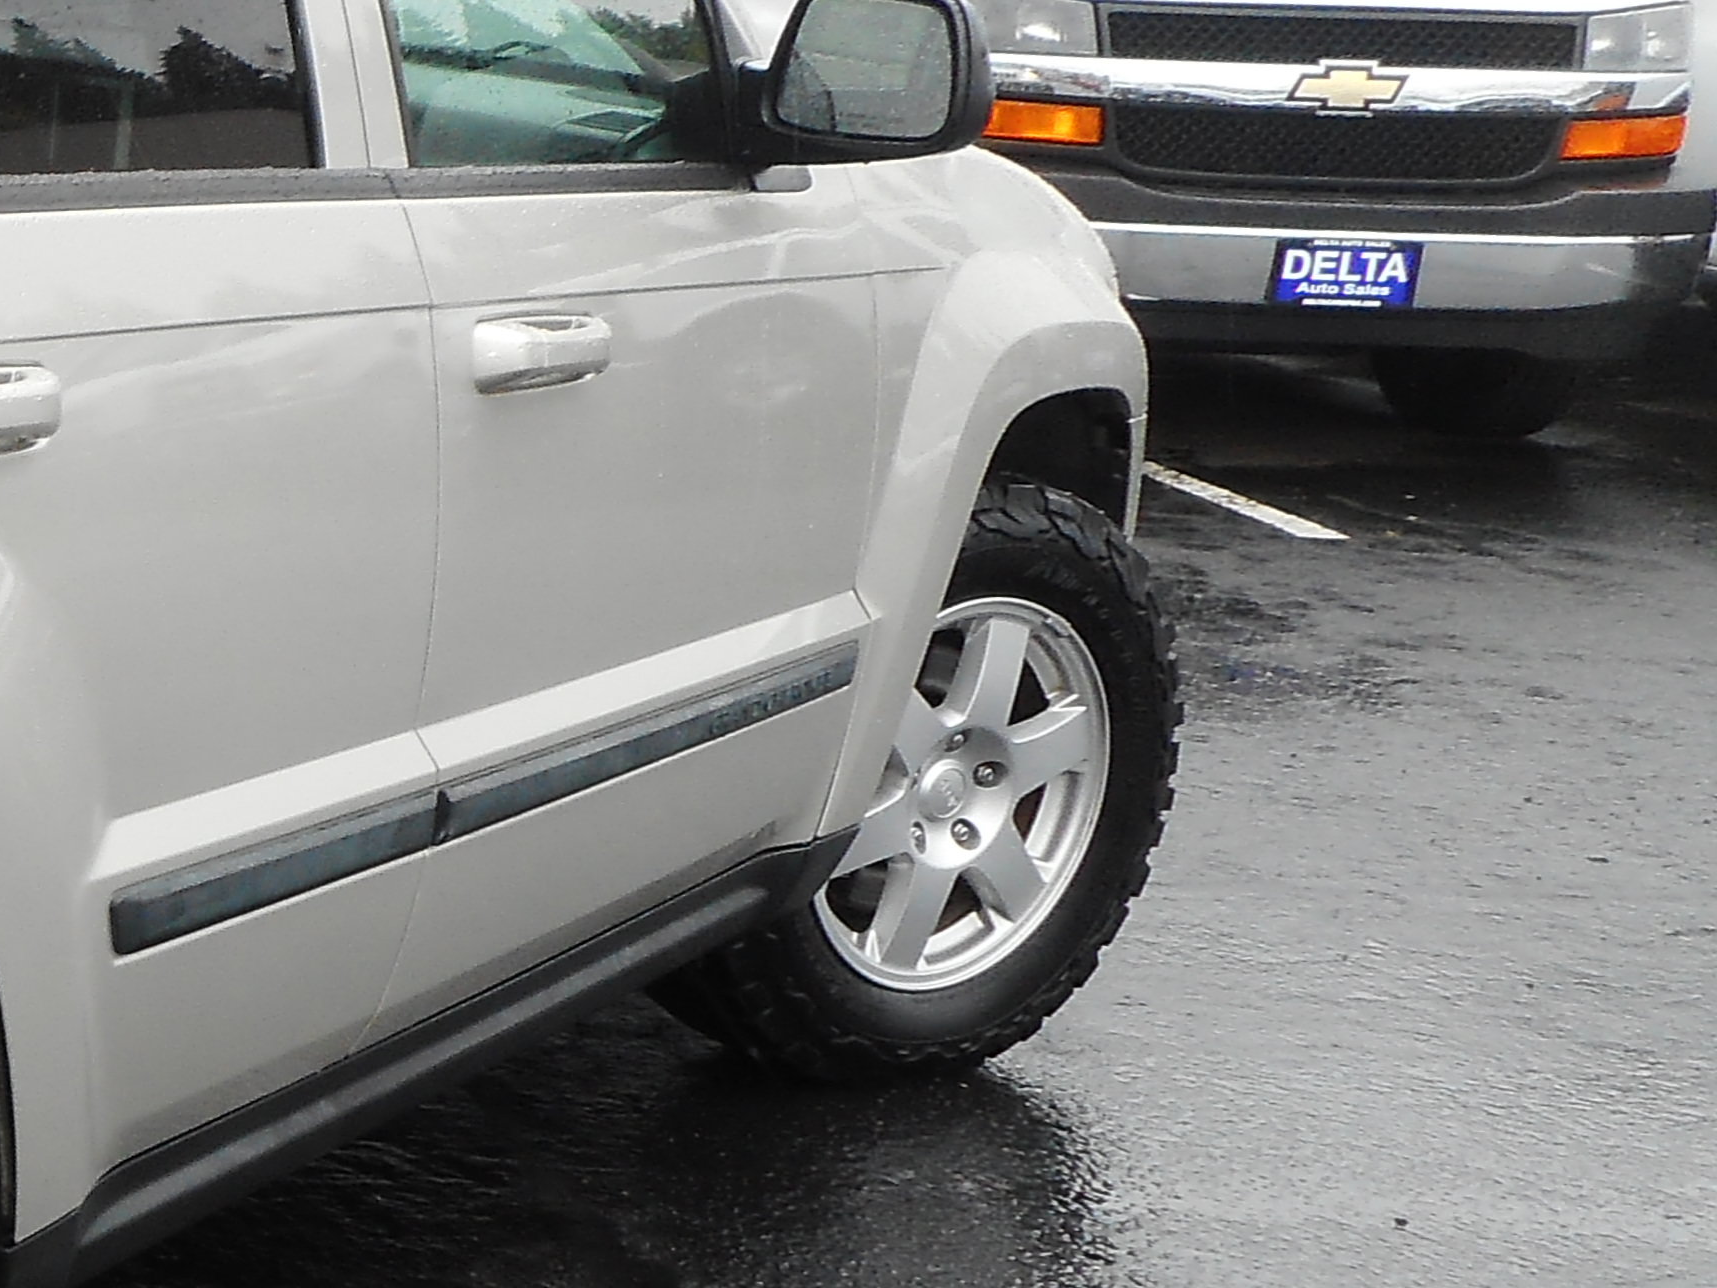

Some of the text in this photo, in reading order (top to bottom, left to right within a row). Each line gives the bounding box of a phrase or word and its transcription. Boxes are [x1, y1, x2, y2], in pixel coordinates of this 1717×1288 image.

[1280, 248, 1409, 283] DELTA
[1294, 281, 1391, 296] Auto Sales
